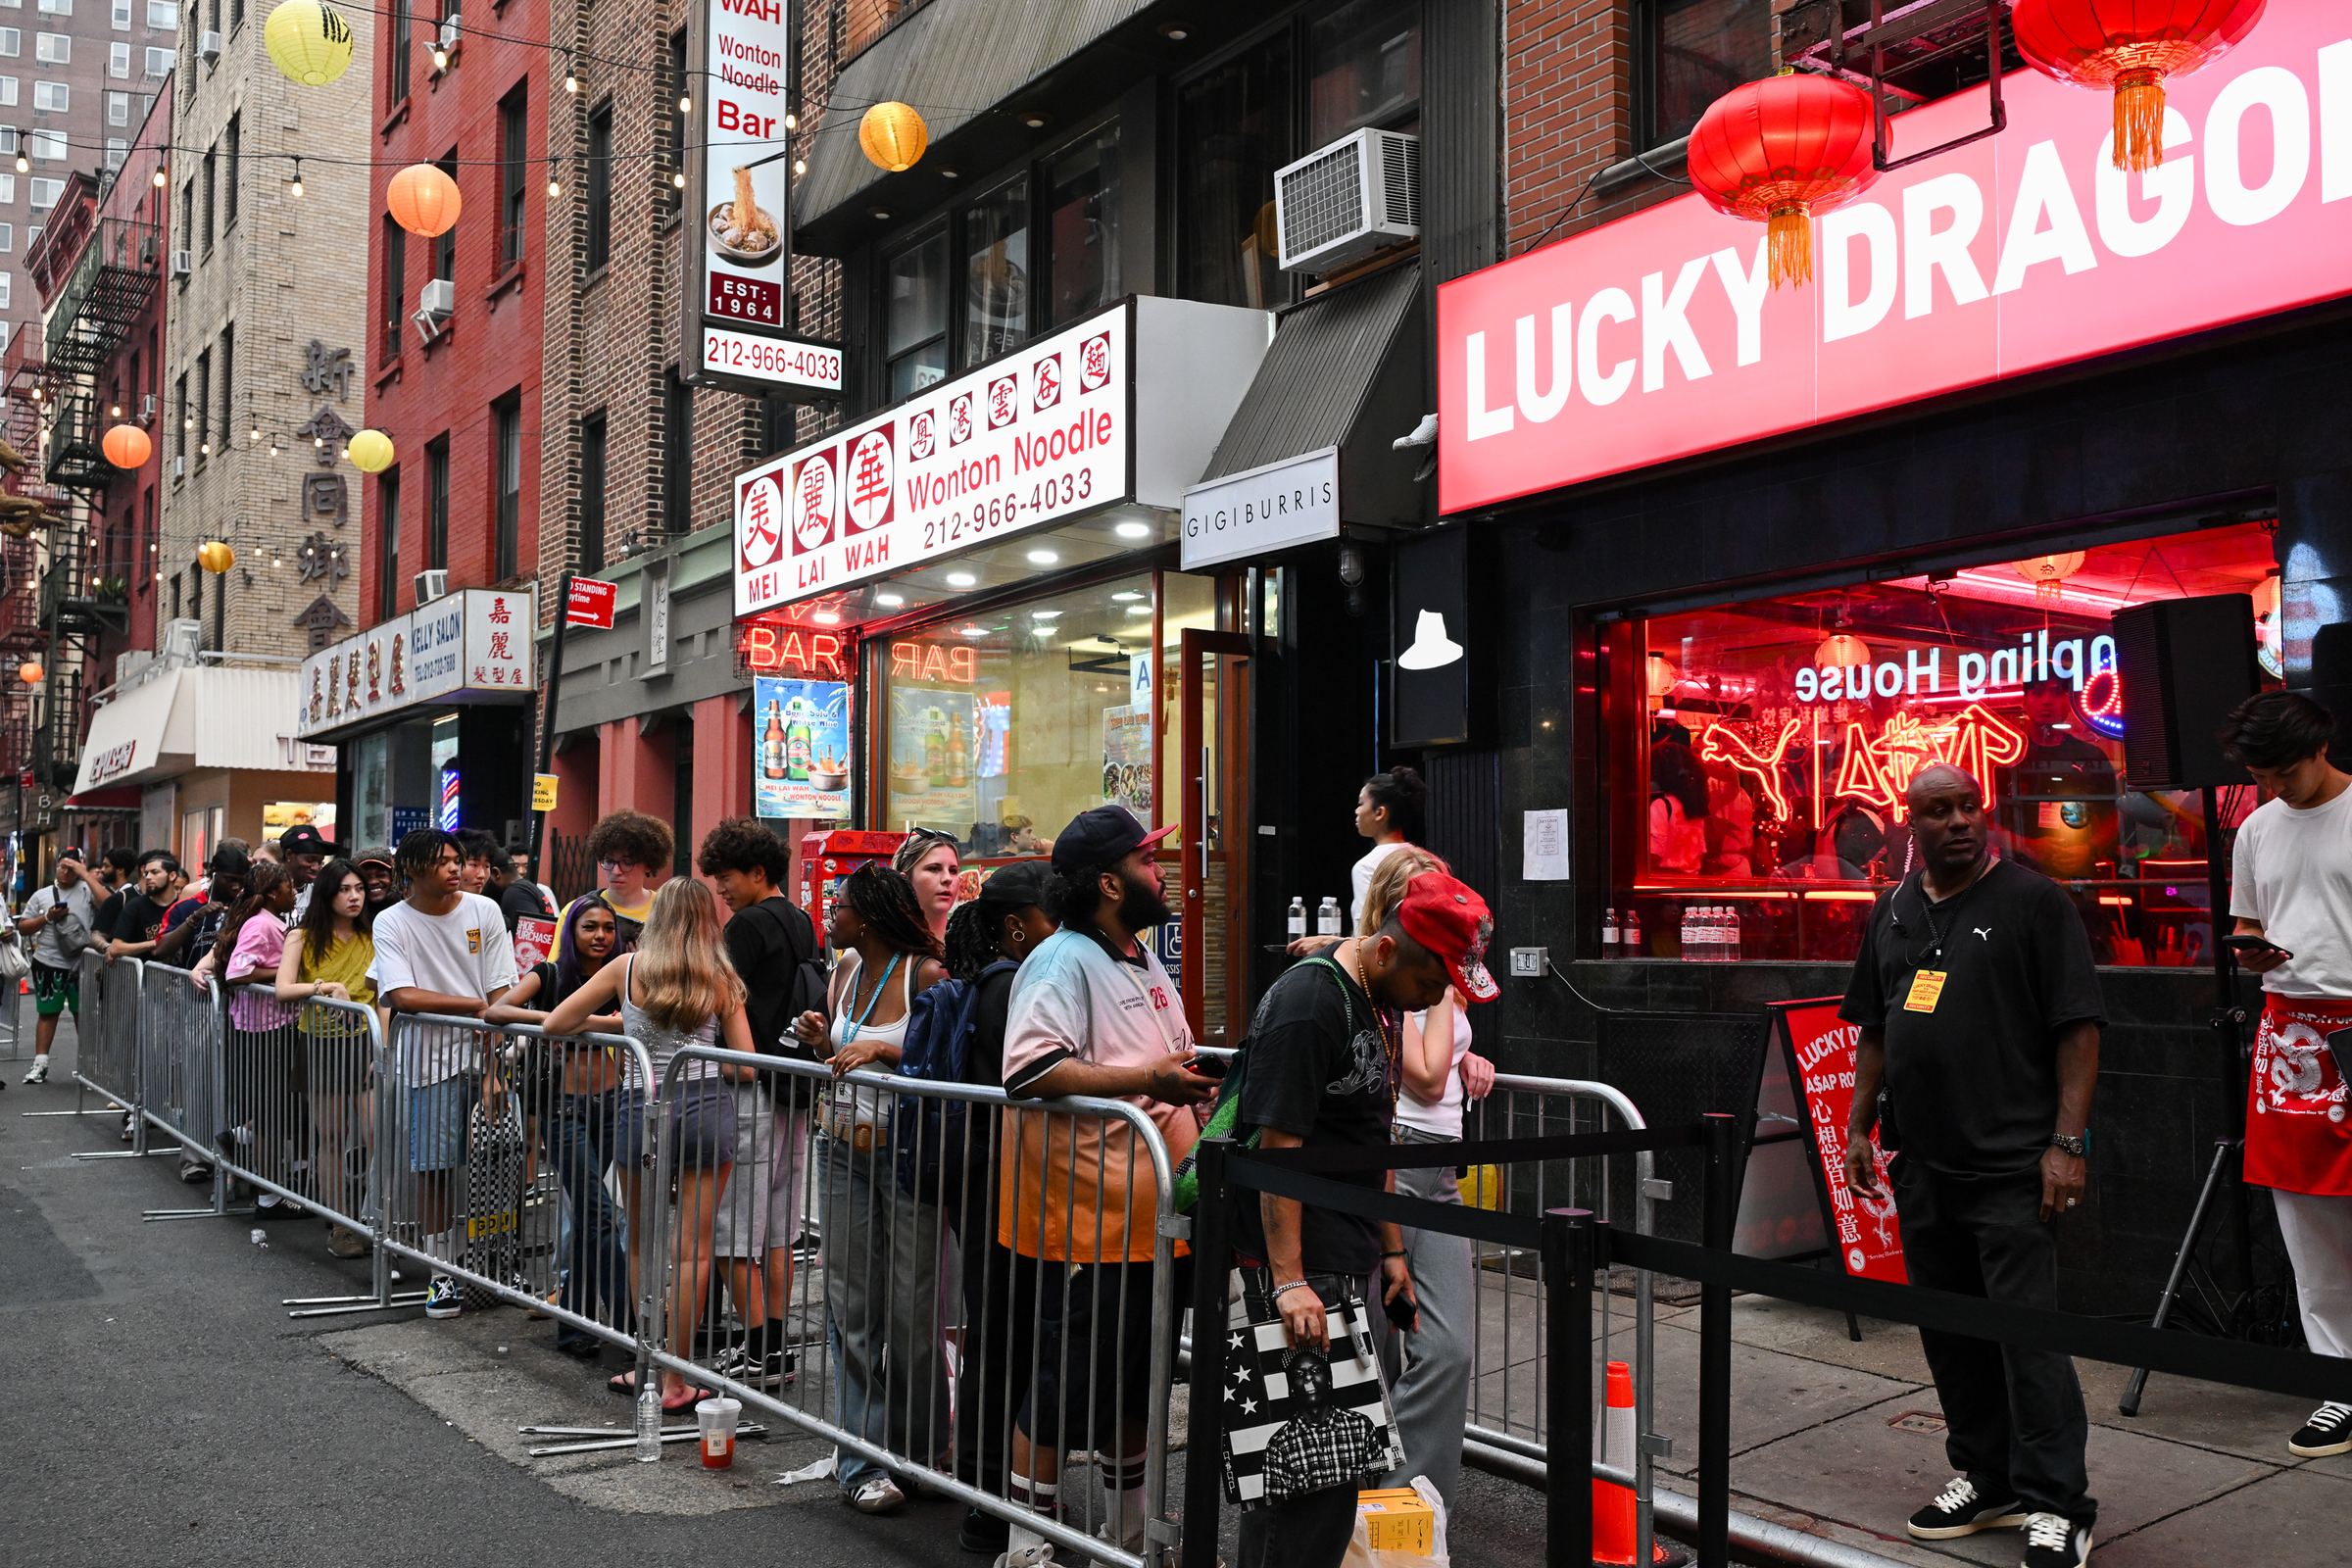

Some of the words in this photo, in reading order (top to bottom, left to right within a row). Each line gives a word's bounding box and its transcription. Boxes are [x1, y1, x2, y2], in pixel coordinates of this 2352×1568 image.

[721, 0, 781, 24] WAH
[718, 33, 781, 69] Wonton
[721, 63, 779, 95] Noodle
[717, 99, 776, 139] Bar
[1466, 235, 1771, 443] LUCKY
[1822, 37, 2352, 343] DRAGO
[723, 280, 767, 301] EST:
[708, 336, 840, 381] 212-966-4033
[907, 454, 1001, 514] Wonton
[1013, 407, 1112, 476] Noodle
[745, 439, 890, 551] 美麗華
[924, 467, 1092, 549] 212-966-4033
[574, 582, 608, 596] STANDING
[749, 571, 778, 604] MEI
[799, 556, 825, 588] LAI
[845, 534, 889, 572] WAH
[412, 624, 433, 654] KELLY
[436, 611, 461, 646] SALON
[488, 597, 513, 661] 嘉麗
[750, 627, 841, 675] BAR
[473, 666, 524, 685] 髮型屋
[516, 929, 553, 945] PURCHASE
[1150, 986, 1168, 1012] 26
[1796, 1027, 1845, 1072] LUCKY
[1806, 1074, 1838, 1095] A$AP
[1812, 1098, 1862, 1245] 心想皆如意
